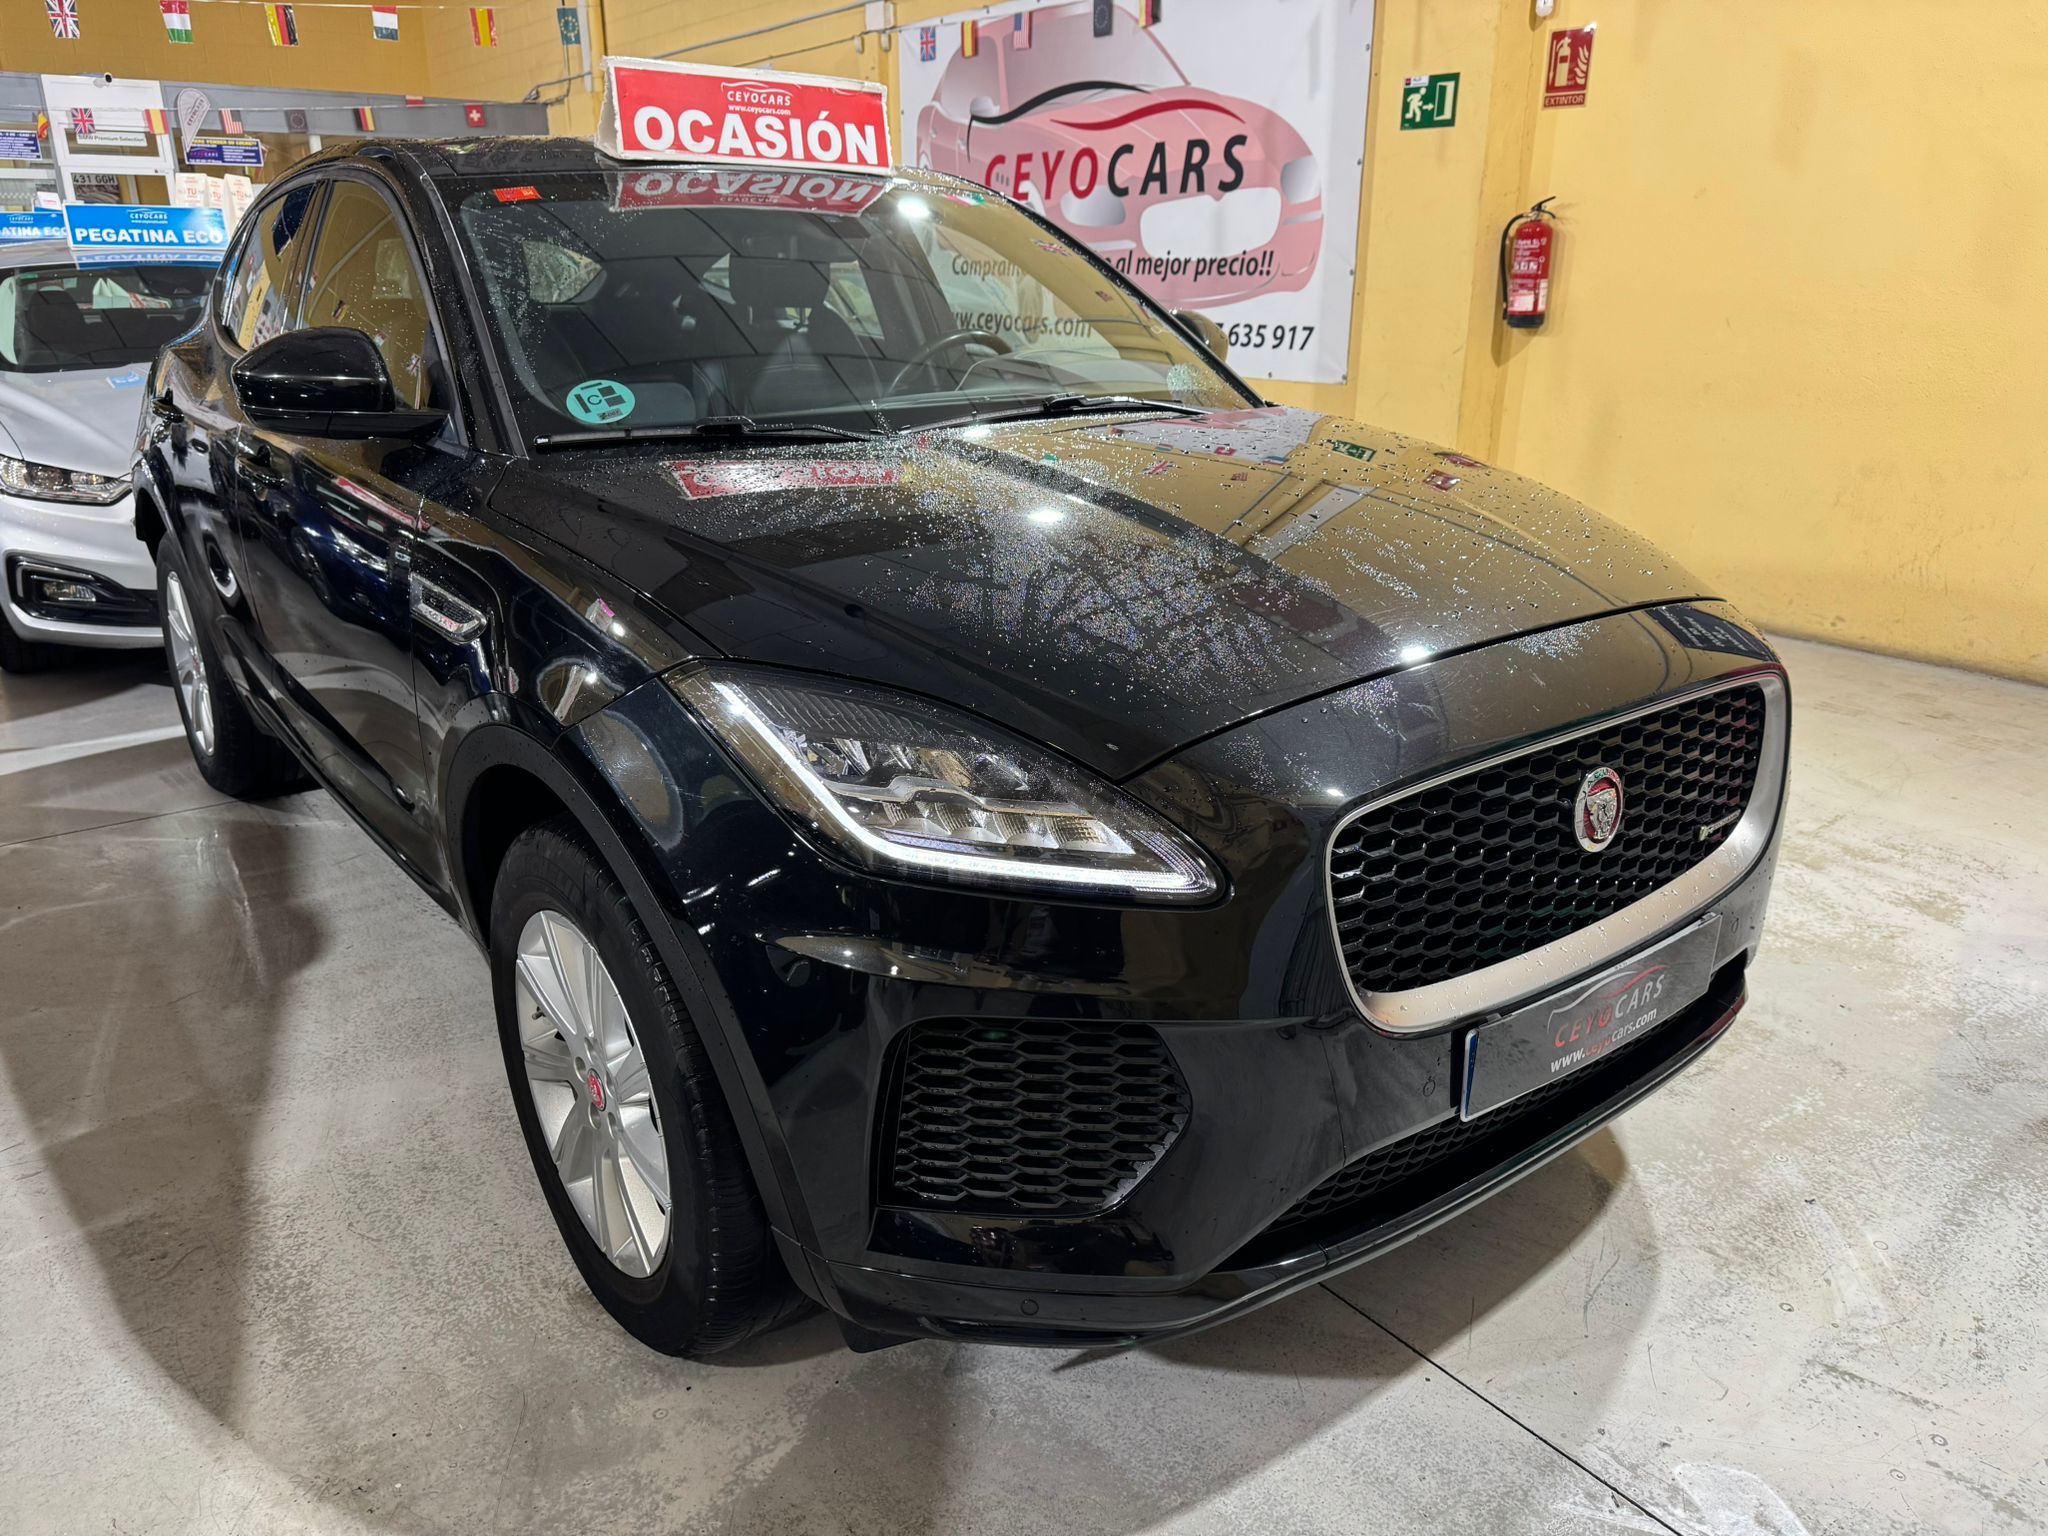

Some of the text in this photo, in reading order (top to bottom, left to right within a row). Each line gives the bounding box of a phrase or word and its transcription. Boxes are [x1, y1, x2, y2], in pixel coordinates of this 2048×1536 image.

[726, 90, 792, 107] CEYOCARS
[727, 104, 792, 116] www.ceyocars.com
[1545, 95, 1584, 106] EXTINTOR
[633, 110, 879, 165] OCASIÓN
[984, 134, 1249, 201] CEYOCARS
[2, 226, 41, 236] ATINA
[74, 227, 225, 245] PEGATINA ECO
[1115, 249, 1133, 275] al
[1135, 255, 1192, 282] mejor
[1194, 249, 1274, 282] precio!!
[954, 311, 1092, 338] w.ceyocars.com
[1228, 322, 1315, 350] 635 917
[1554, 974, 1665, 1048] CEYOCARS
[1550, 1008, 1657, 1073] www.ceyocars.com
